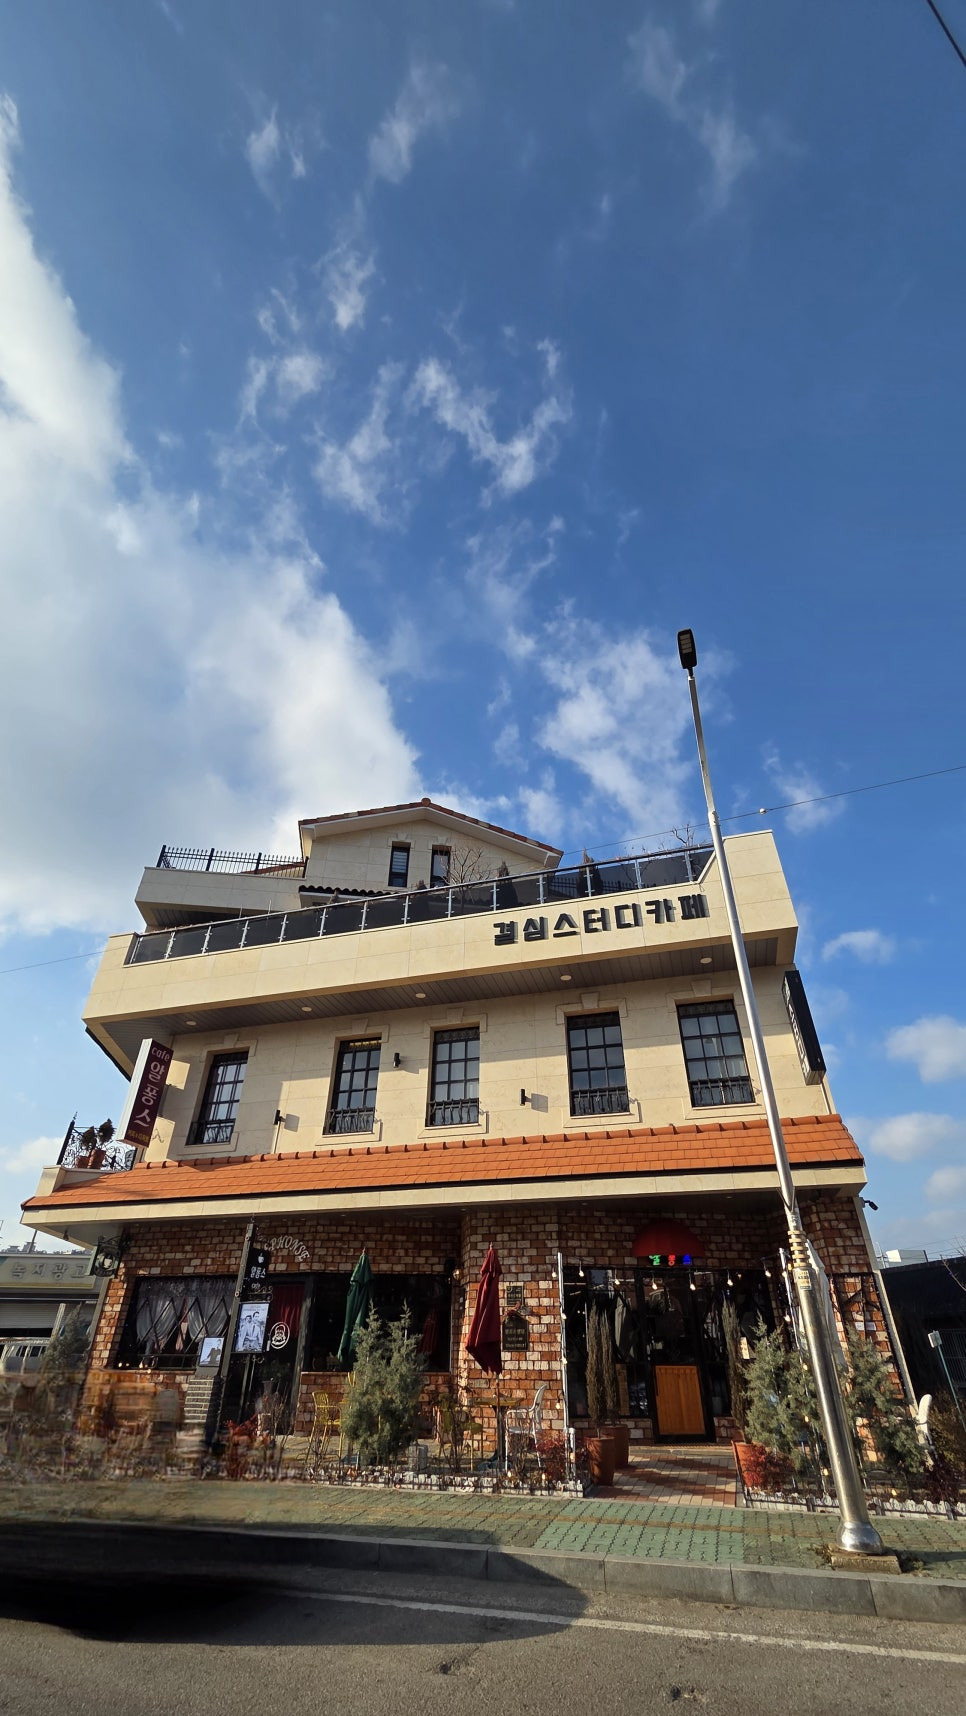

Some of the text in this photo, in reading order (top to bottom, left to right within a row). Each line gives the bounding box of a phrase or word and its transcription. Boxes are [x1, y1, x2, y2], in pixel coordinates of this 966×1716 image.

[493, 894, 708, 946] 결심스터디카페
[151, 1047, 171, 1062] cafe
[133, 1061, 166, 1127] 알퐁스
